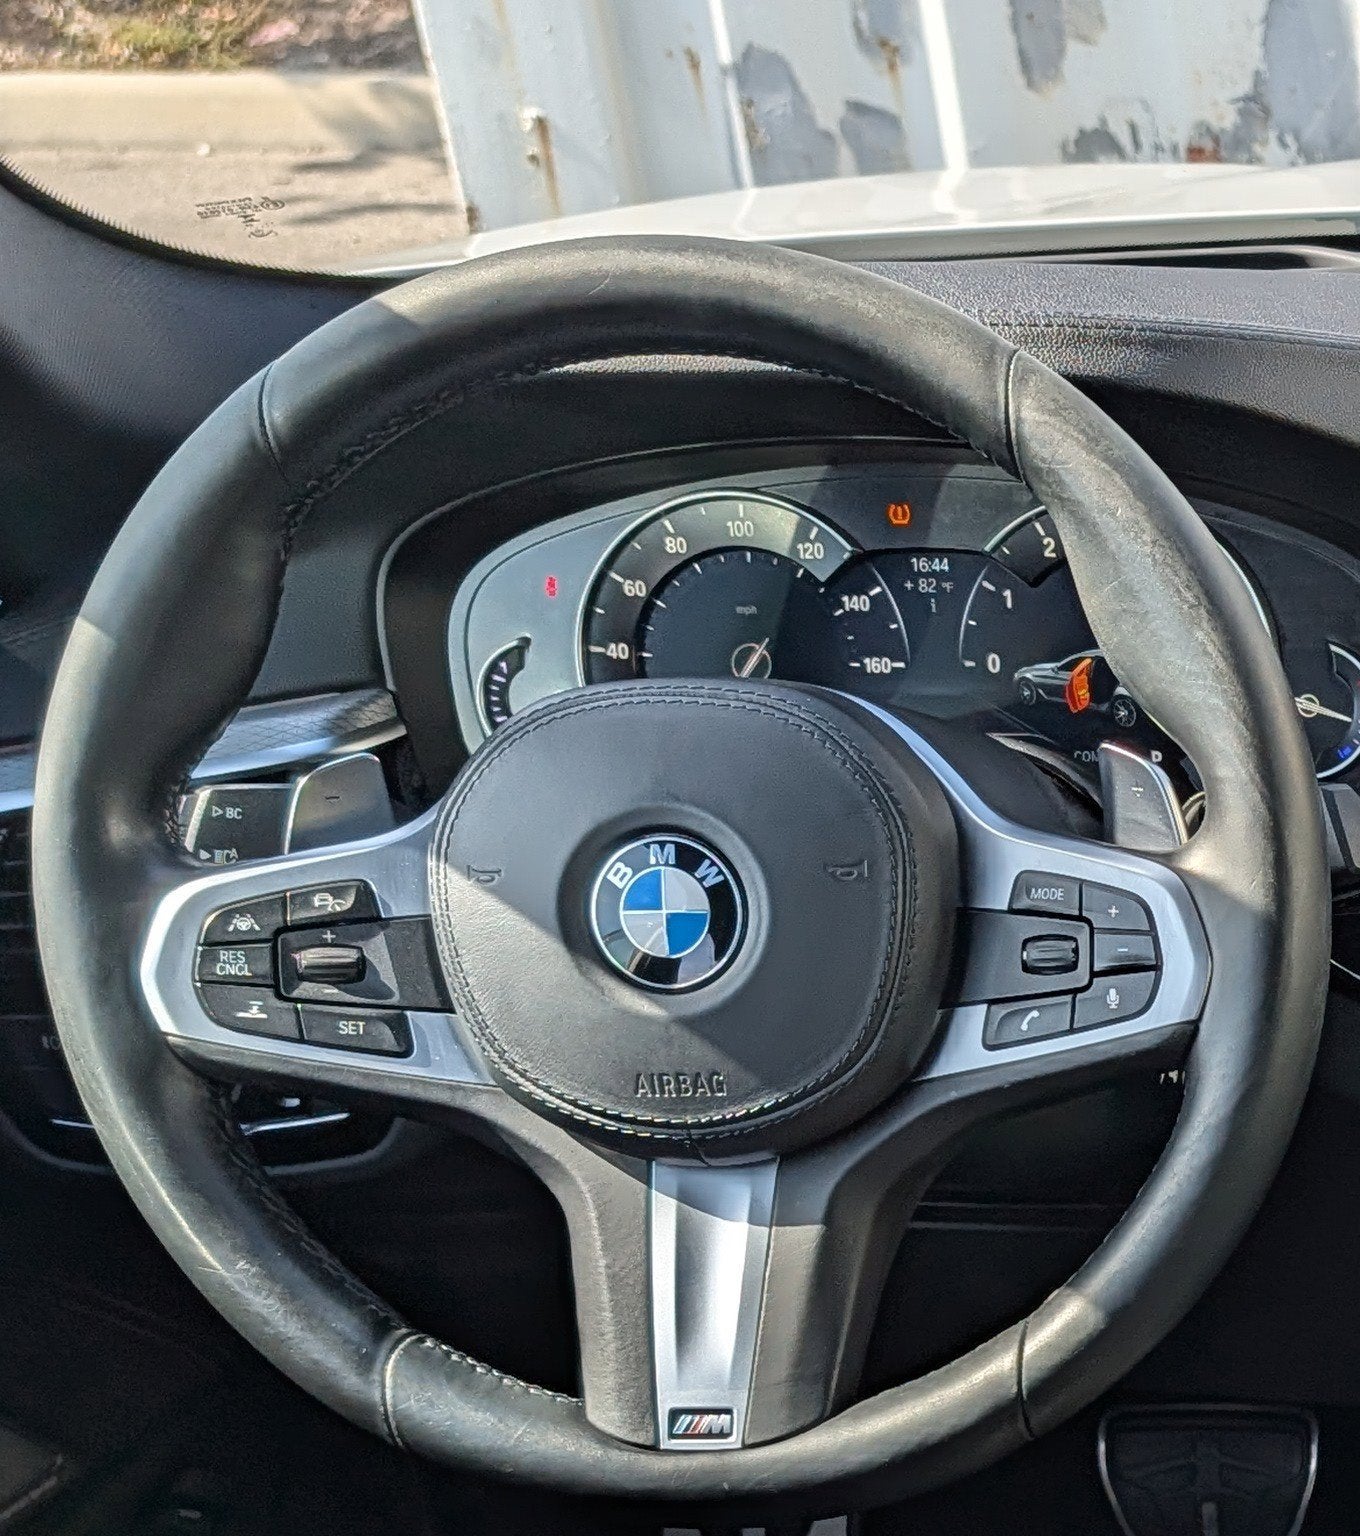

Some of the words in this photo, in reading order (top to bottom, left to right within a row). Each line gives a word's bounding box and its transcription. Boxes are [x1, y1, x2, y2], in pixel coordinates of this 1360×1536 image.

[726, 520, 754, 537] 100
[665, 536, 687, 553] 80
[796, 542, 824, 559] 120
[1043, 538, 1057, 558] 2
[910, 557, 950, 573] 16:44
[623, 580, 647, 597] 60
[918, 578, 937, 593] 82
[841, 595, 871, 612] 140
[1002, 590, 1013, 609] 1
[735, 605, 758, 615] mph
[606, 643, 629, 660] 40
[863, 657, 891, 674] 160
[986, 653, 1001, 674] 0
[606, 843, 726, 890] BMW
[1029, 887, 1065, 902] MODE
[219, 950, 246, 963] RES
[215, 962, 253, 976] CNCL
[338, 1020, 366, 1036] SET
[635, 1072, 728, 1099] AIRBAG
